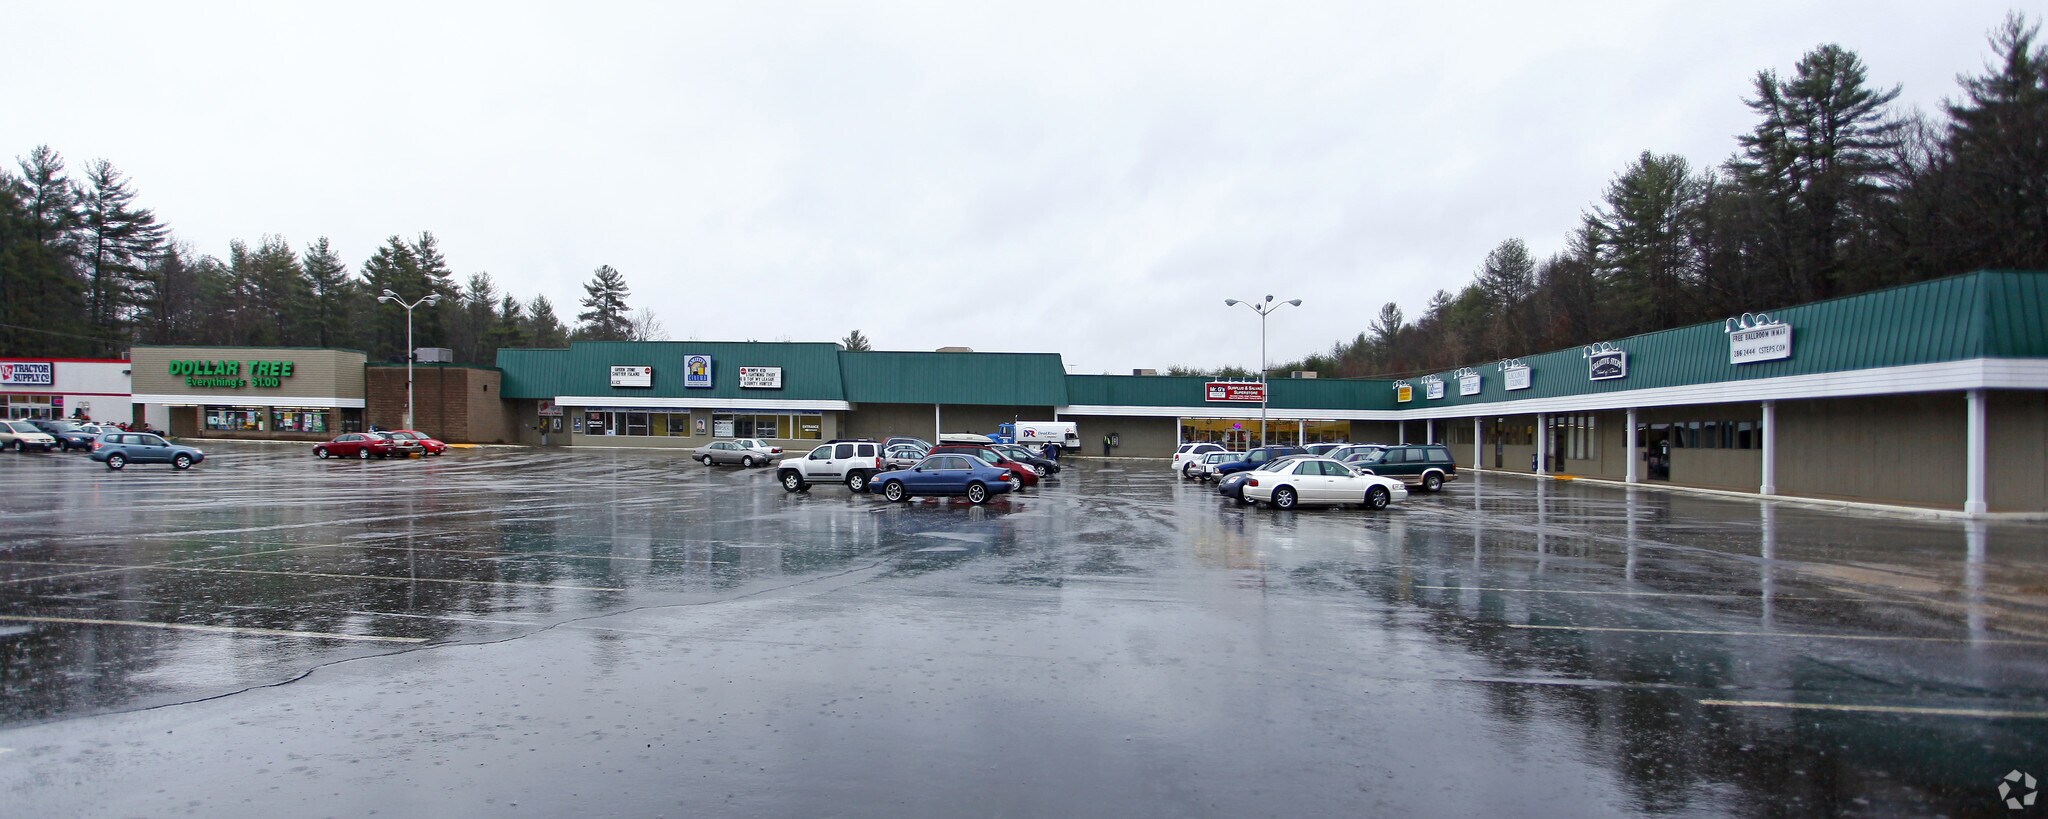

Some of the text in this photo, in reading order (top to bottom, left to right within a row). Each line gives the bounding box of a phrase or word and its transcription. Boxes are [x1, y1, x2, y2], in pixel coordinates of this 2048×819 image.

[1733, 334, 1743, 342] FREE
[1745, 331, 1769, 340] BALLROOM
[14, 364, 49, 373] TRACTOR
[168, 360, 294, 376] DOLLAR TREE
[1591, 358, 1610, 371] CREATIVE
[186, 377, 279, 388] Everything's $1.00
